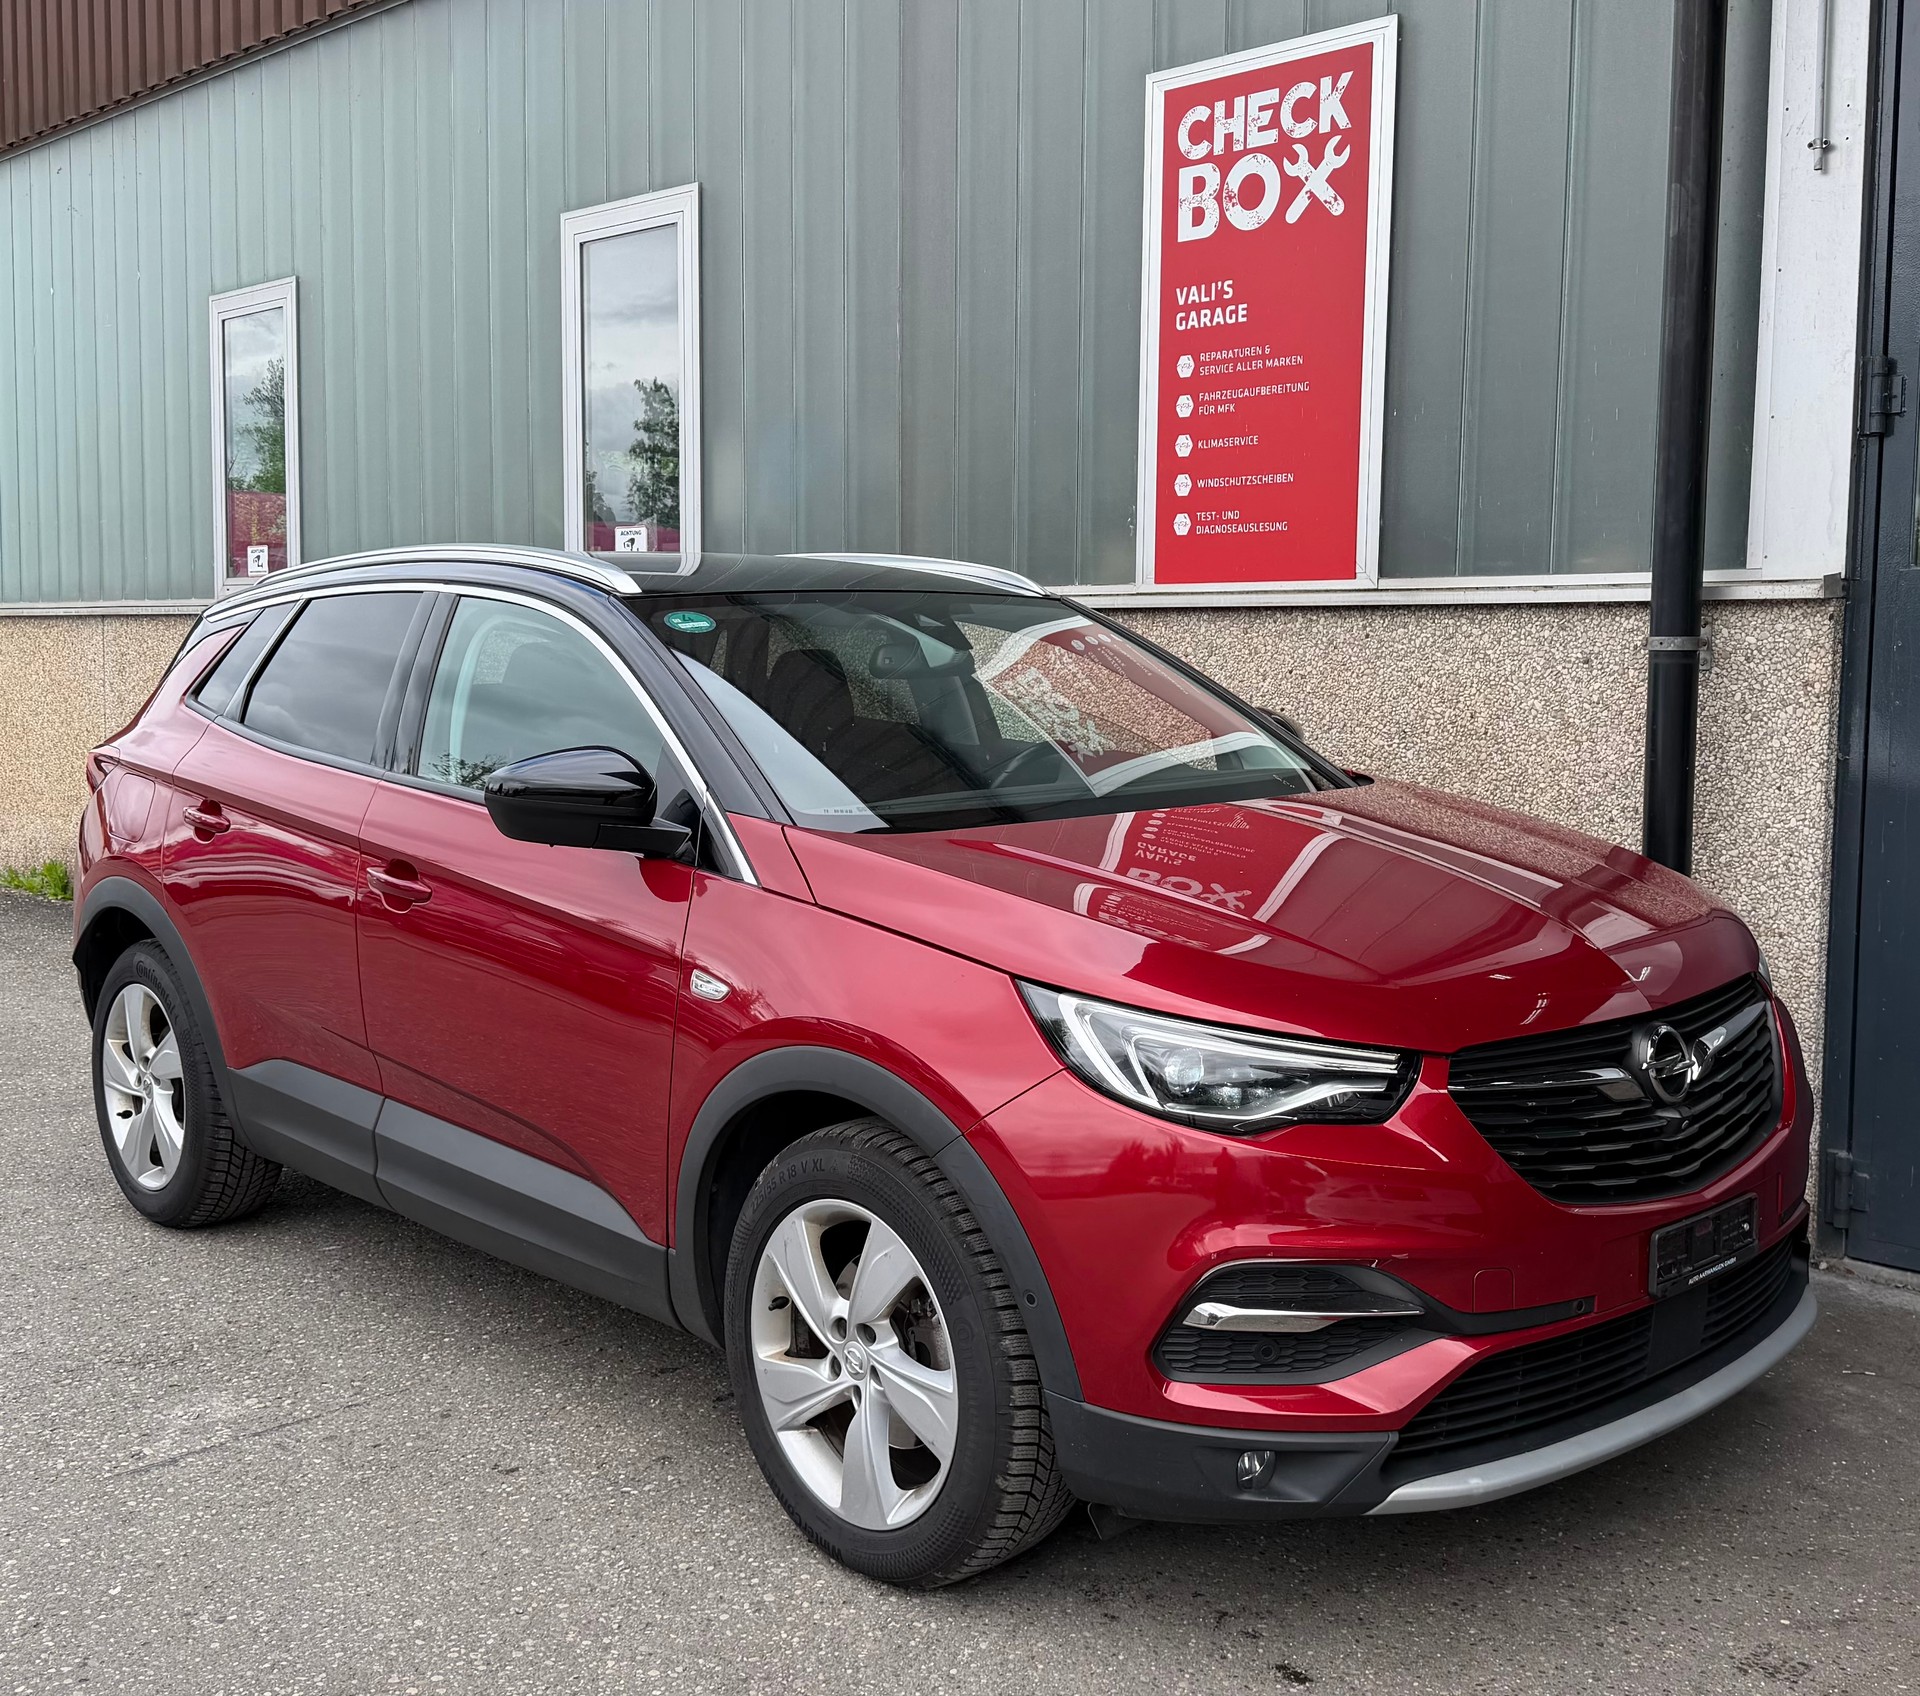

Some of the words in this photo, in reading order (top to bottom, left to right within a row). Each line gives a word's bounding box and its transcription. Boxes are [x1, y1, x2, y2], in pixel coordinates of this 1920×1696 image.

[1177, 70, 1354, 160] CHECK
[1177, 135, 1351, 243] BOX
[1175, 279, 1234, 306] VALI'S
[1175, 303, 1248, 331] GARAGE
[1199, 346, 1263, 362] REPARATUREN
[1265, 344, 1271, 354] &
[1199, 362, 1234, 376] SERVICE
[1236, 359, 1263, 372] ALLER
[1265, 355, 1304, 368] MARKEN
[1198, 381, 1310, 402] FAHRZEUGAUFBEREITUNG
[1198, 404, 1215, 416] FÜR
[1217, 403, 1236, 414] MFK
[1197, 435, 1259, 449] KLIMASERVICE
[1196, 472, 1294, 488] WINDSCHUTZSCHEIBEN
[1196, 511, 1220, 521] TEST-
[1221, 510, 1240, 520] UND
[1196, 521, 1288, 535] DIAGNOSEAUSLESUNG
[786, 1164, 797, 1180] 18
[812, 1158, 825, 1172] XL
